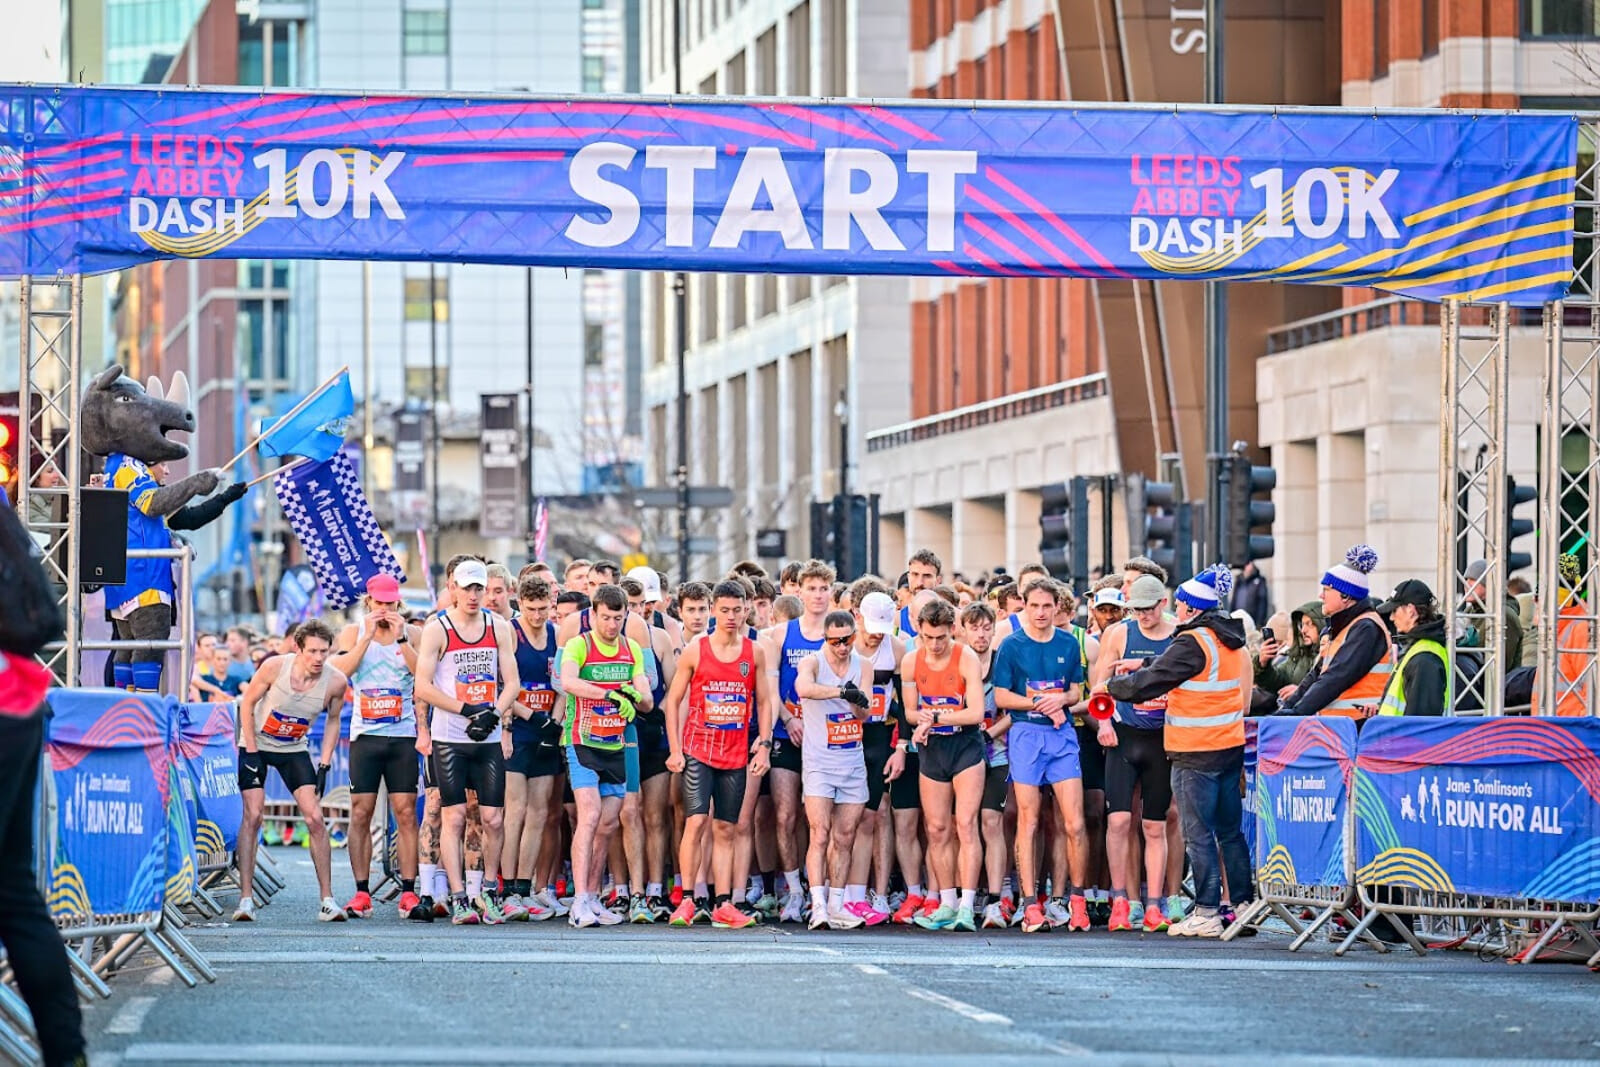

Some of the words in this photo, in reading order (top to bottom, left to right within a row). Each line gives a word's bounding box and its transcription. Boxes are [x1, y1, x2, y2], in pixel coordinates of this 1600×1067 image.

[1169, 0, 1207, 54] SI
[130, 133, 245, 167] LEEDS
[131, 167, 244, 197] ABBEY
[253, 148, 406, 220] 10K
[1130, 153, 1242, 187] LEEDS
[564, 141, 978, 252] START
[1131, 187, 1242, 217] ABBEY
[1250, 167, 1400, 239] 10K
[129, 197, 244, 234] DASH
[1130, 217, 1243, 254] DASH
[320, 509, 340, 537] RUN
[333, 538, 351, 565] FOR
[344, 564, 363, 588] ALL
[453, 650, 493, 665] GATESHEAD
[457, 663, 491, 676] HARRIERS
[367, 699, 397, 710] 10089
[466, 684, 487, 695] 454
[525, 693, 550, 704] 10111
[712, 705, 740, 715] 9009
[833, 723, 858, 734] 7410
[1446, 777, 1470, 793] Jane
[1472, 778, 1533, 798] Tomlinson's
[87, 800, 108, 834] RUN
[108, 800, 126, 834] FOR
[127, 801, 144, 834] ALL
[1292, 796, 1308, 822] RUN
[1308, 796, 1323, 822] FOR
[1324, 796, 1337, 822] ALL
[1445, 799, 1485, 829] RUN
[1489, 802, 1525, 832] FOR
[1529, 805, 1563, 835] ALL
